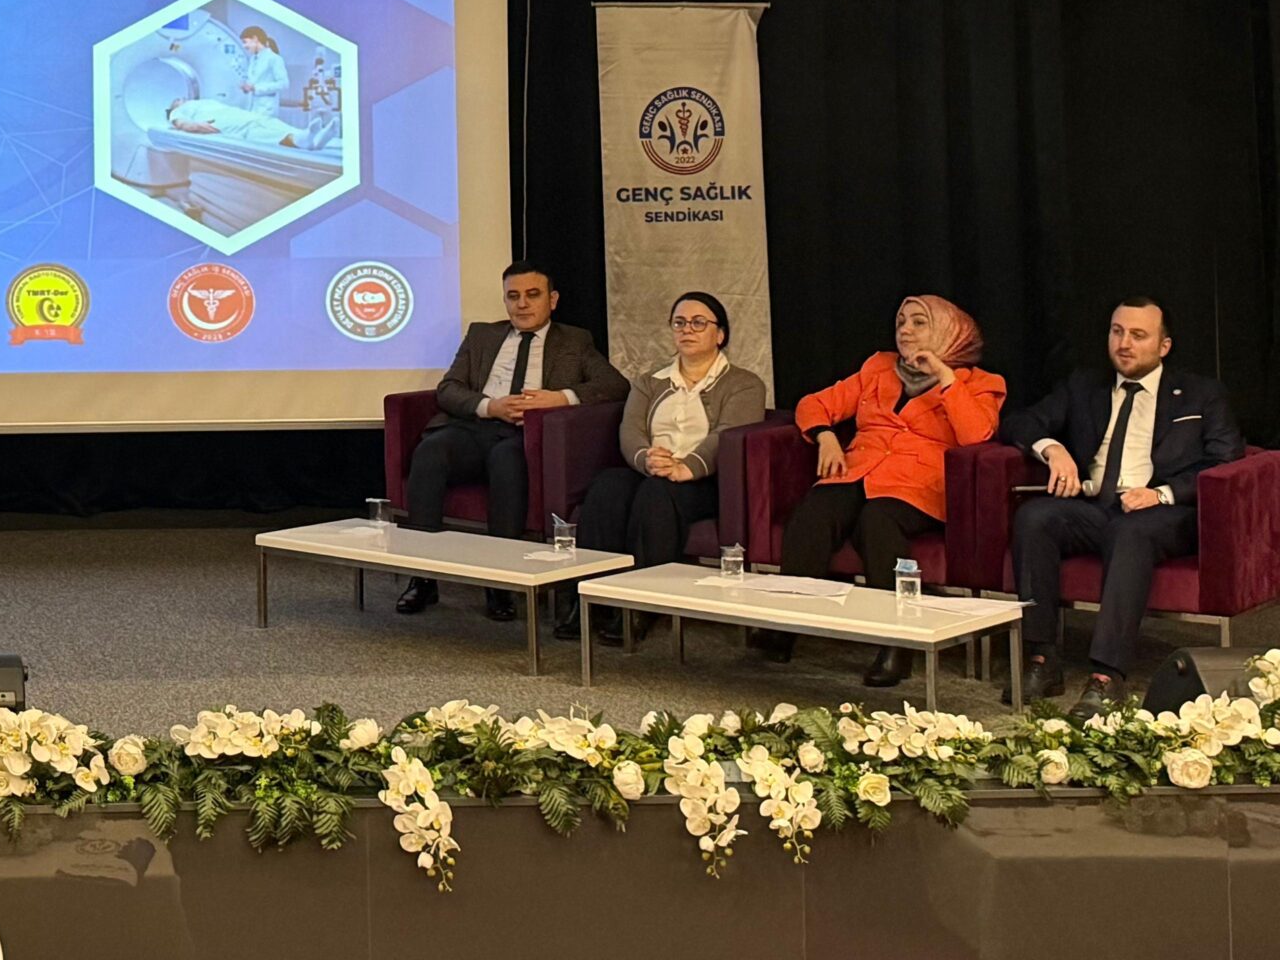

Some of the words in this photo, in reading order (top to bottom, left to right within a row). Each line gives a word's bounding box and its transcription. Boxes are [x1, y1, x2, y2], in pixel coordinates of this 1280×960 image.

[654, 89, 689, 108] SAĞLIK
[691, 90, 723, 131] SENDİKASI
[675, 156, 696, 164] 2022
[616, 187, 674, 205] GENÇ
[679, 182, 752, 201] SAĞLIK
[644, 207, 724, 223] SENDİKASI
